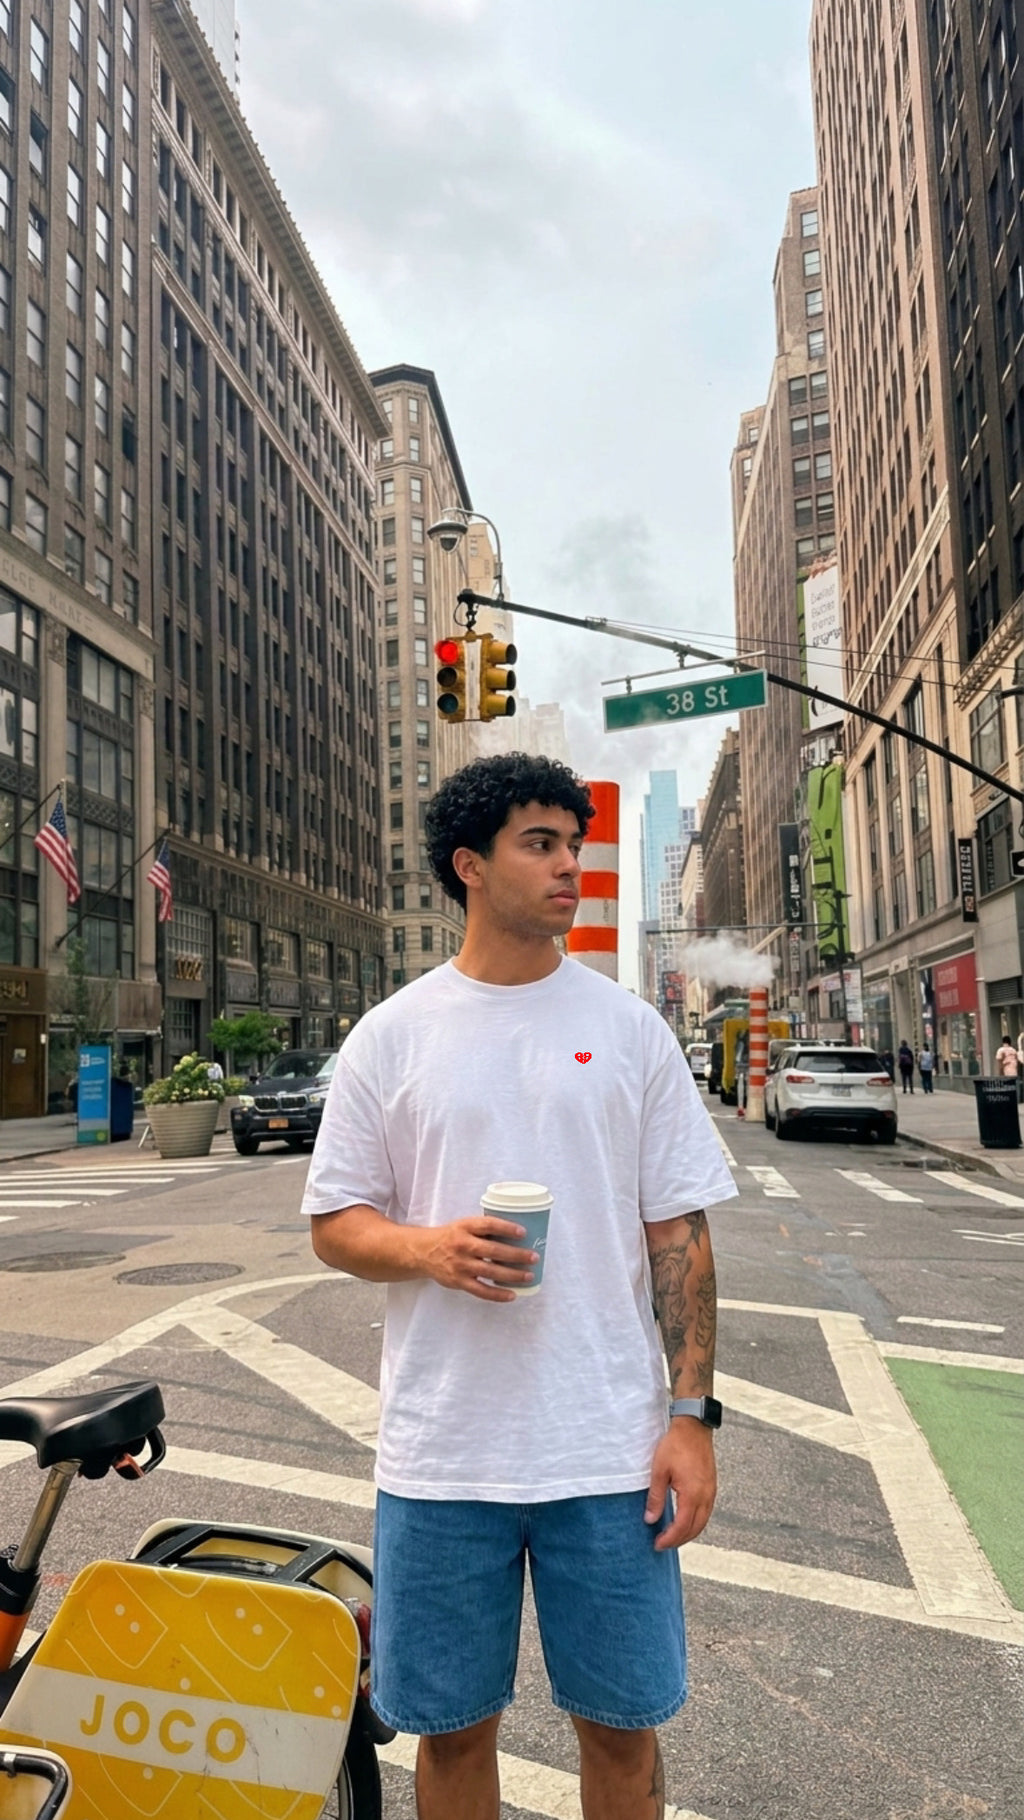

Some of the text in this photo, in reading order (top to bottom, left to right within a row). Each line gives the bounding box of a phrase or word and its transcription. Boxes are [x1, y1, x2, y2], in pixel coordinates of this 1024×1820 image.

[666, 685, 729, 715] 38 St
[79, 1694, 247, 1764] JOCO
